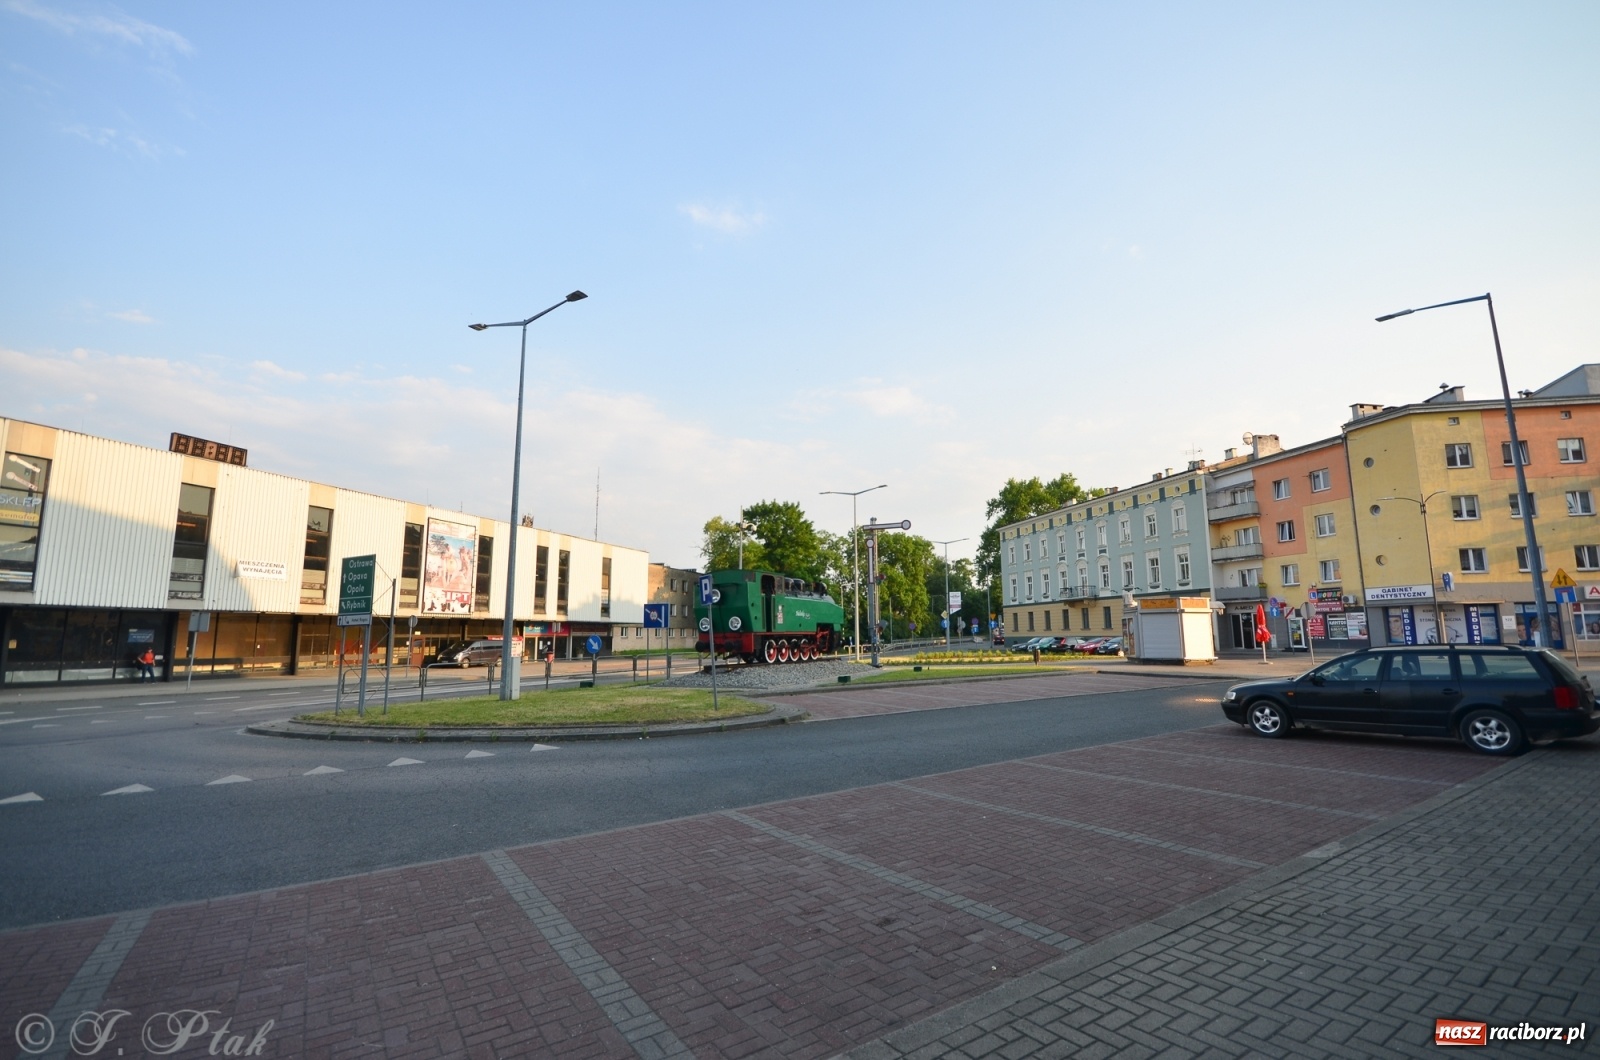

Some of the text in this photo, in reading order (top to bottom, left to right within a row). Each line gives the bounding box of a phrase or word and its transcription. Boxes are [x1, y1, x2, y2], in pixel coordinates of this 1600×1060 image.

[349, 560, 373, 568] Ostrawa
[347, 572, 368, 583] Opava
[346, 584, 365, 595] Opole
[701, 577, 710, 602] P
[1371, 591, 1427, 599] DENTYSTYCZNY
[346, 600, 366, 611] Rybnik
